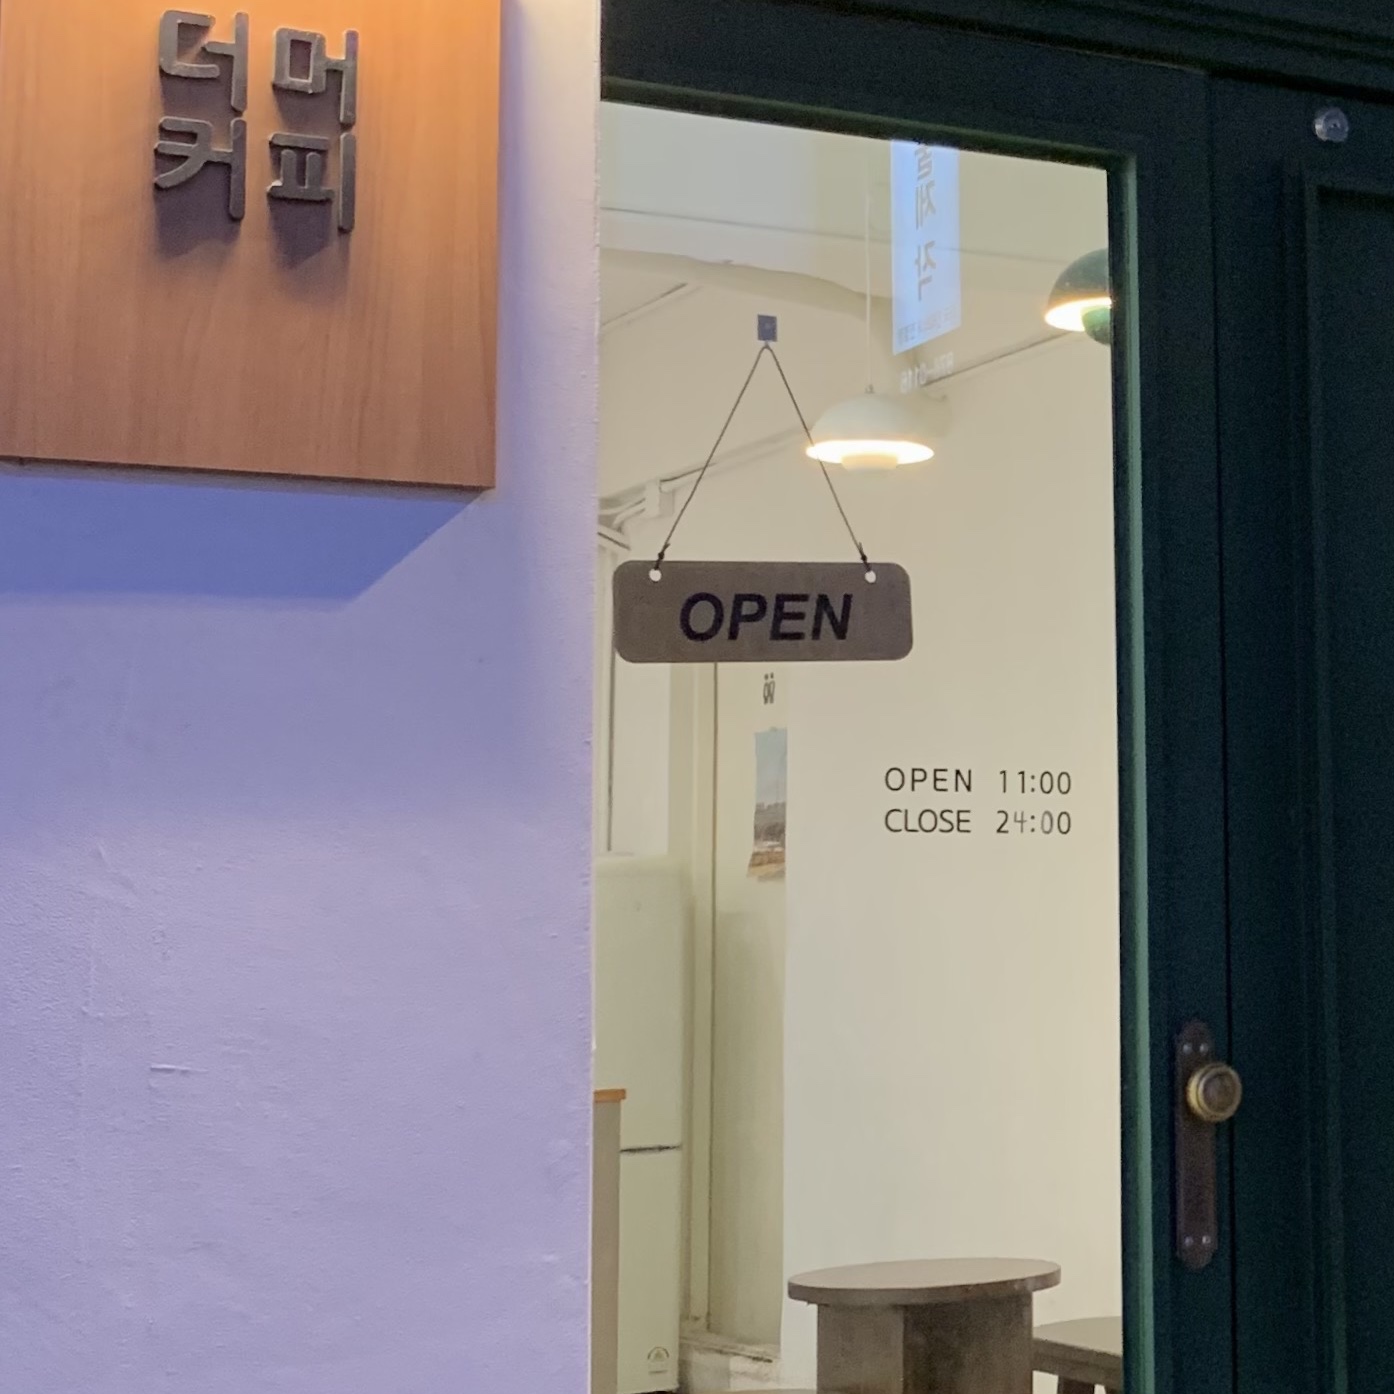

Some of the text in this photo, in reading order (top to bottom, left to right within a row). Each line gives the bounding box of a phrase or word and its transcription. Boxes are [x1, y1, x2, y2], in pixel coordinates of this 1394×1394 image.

[680, 592, 853, 642] OPEN
[885, 767, 1071, 795] OPEN 11:00
[884, 808, 1071, 835] CLOSE 24:00
